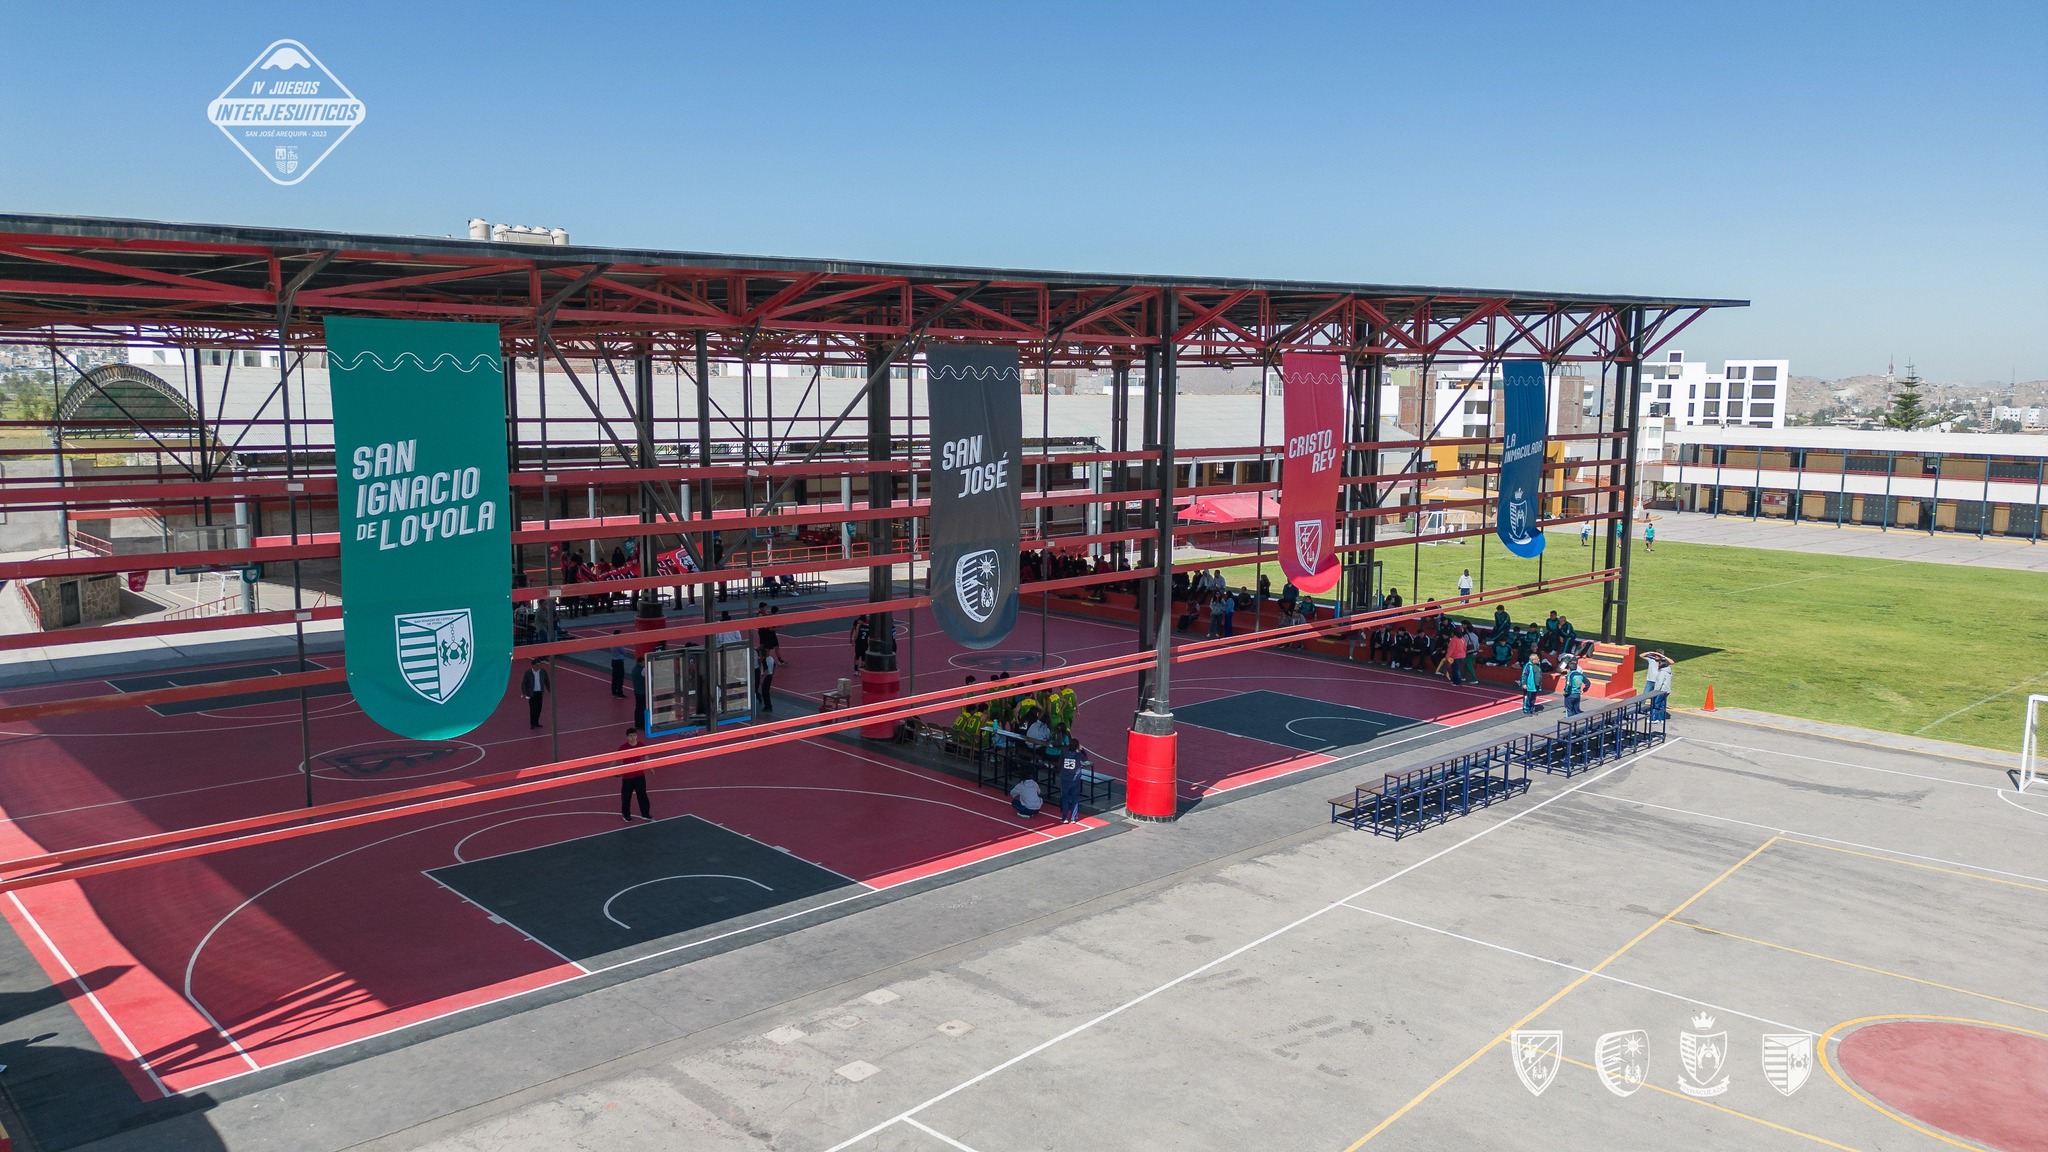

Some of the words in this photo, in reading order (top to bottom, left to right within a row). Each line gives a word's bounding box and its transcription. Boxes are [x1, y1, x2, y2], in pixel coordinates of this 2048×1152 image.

[942, 435, 983, 470] SAN
[1289, 429, 1332, 458] CRISTO
[1504, 440, 1542, 463] INMACULADA
[1506, 433, 1516, 449] LA
[352, 439, 417, 480] SAN
[958, 451, 1009, 498] JOSÉ
[1312, 448, 1336, 473] REY
[356, 466, 480, 518] IGNACIO
[356, 521, 378, 541] DE
[379, 500, 496, 551] LOYOLA
[1064, 761, 1076, 770] 23
